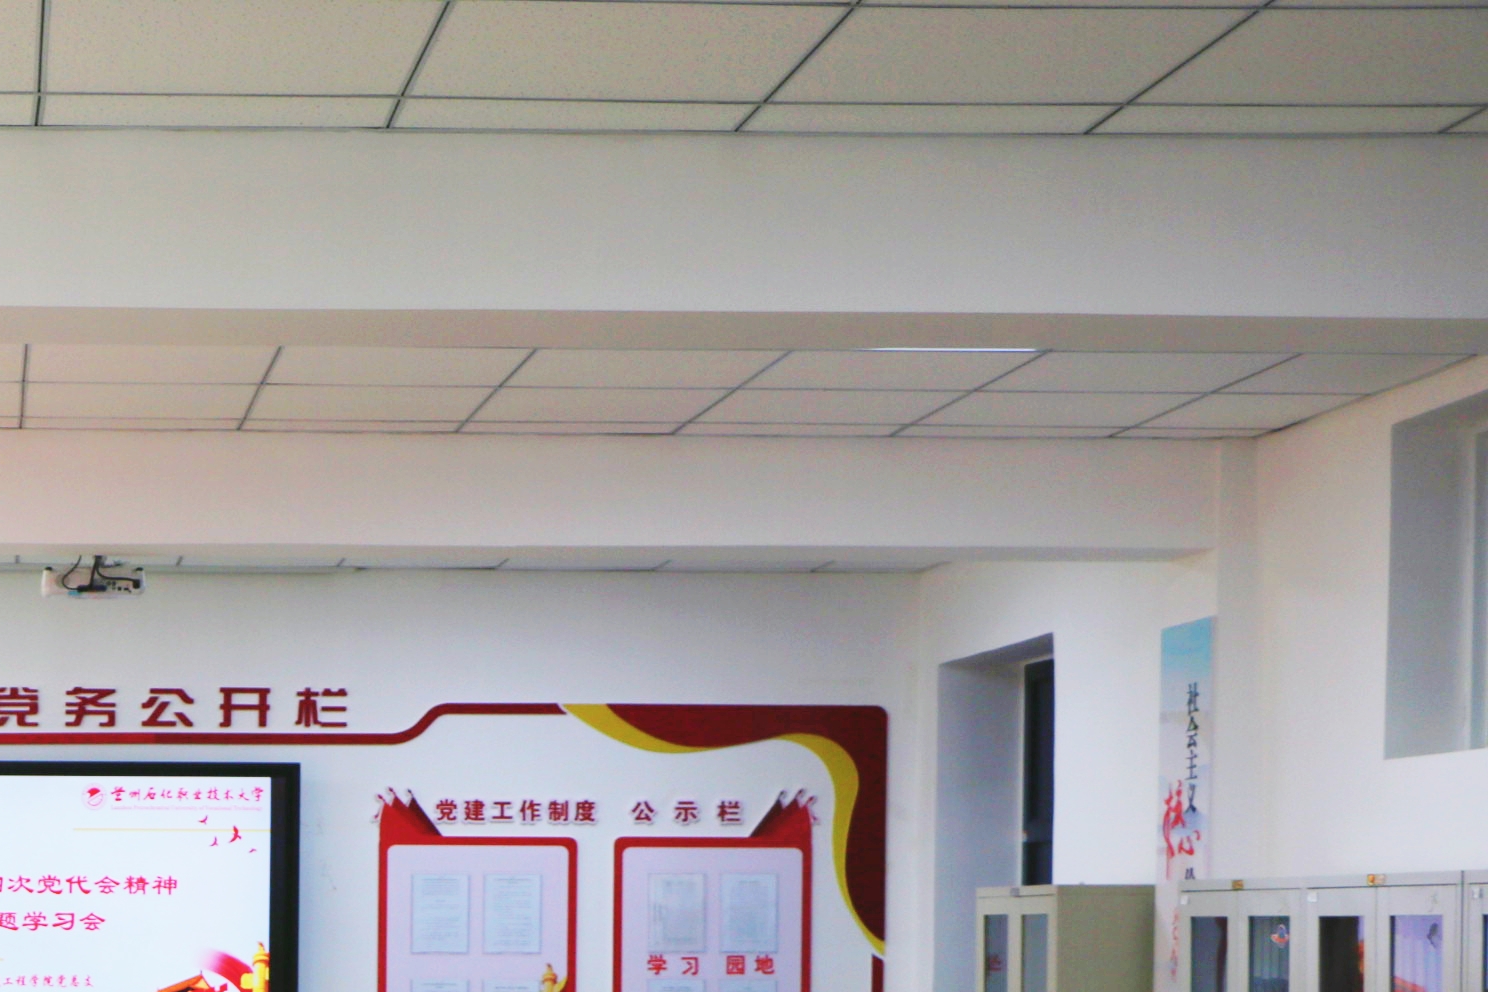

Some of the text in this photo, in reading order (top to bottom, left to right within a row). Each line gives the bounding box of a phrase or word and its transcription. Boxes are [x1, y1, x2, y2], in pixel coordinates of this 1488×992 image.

[435, 799, 743, 823] 党建工作制度 公示栏
